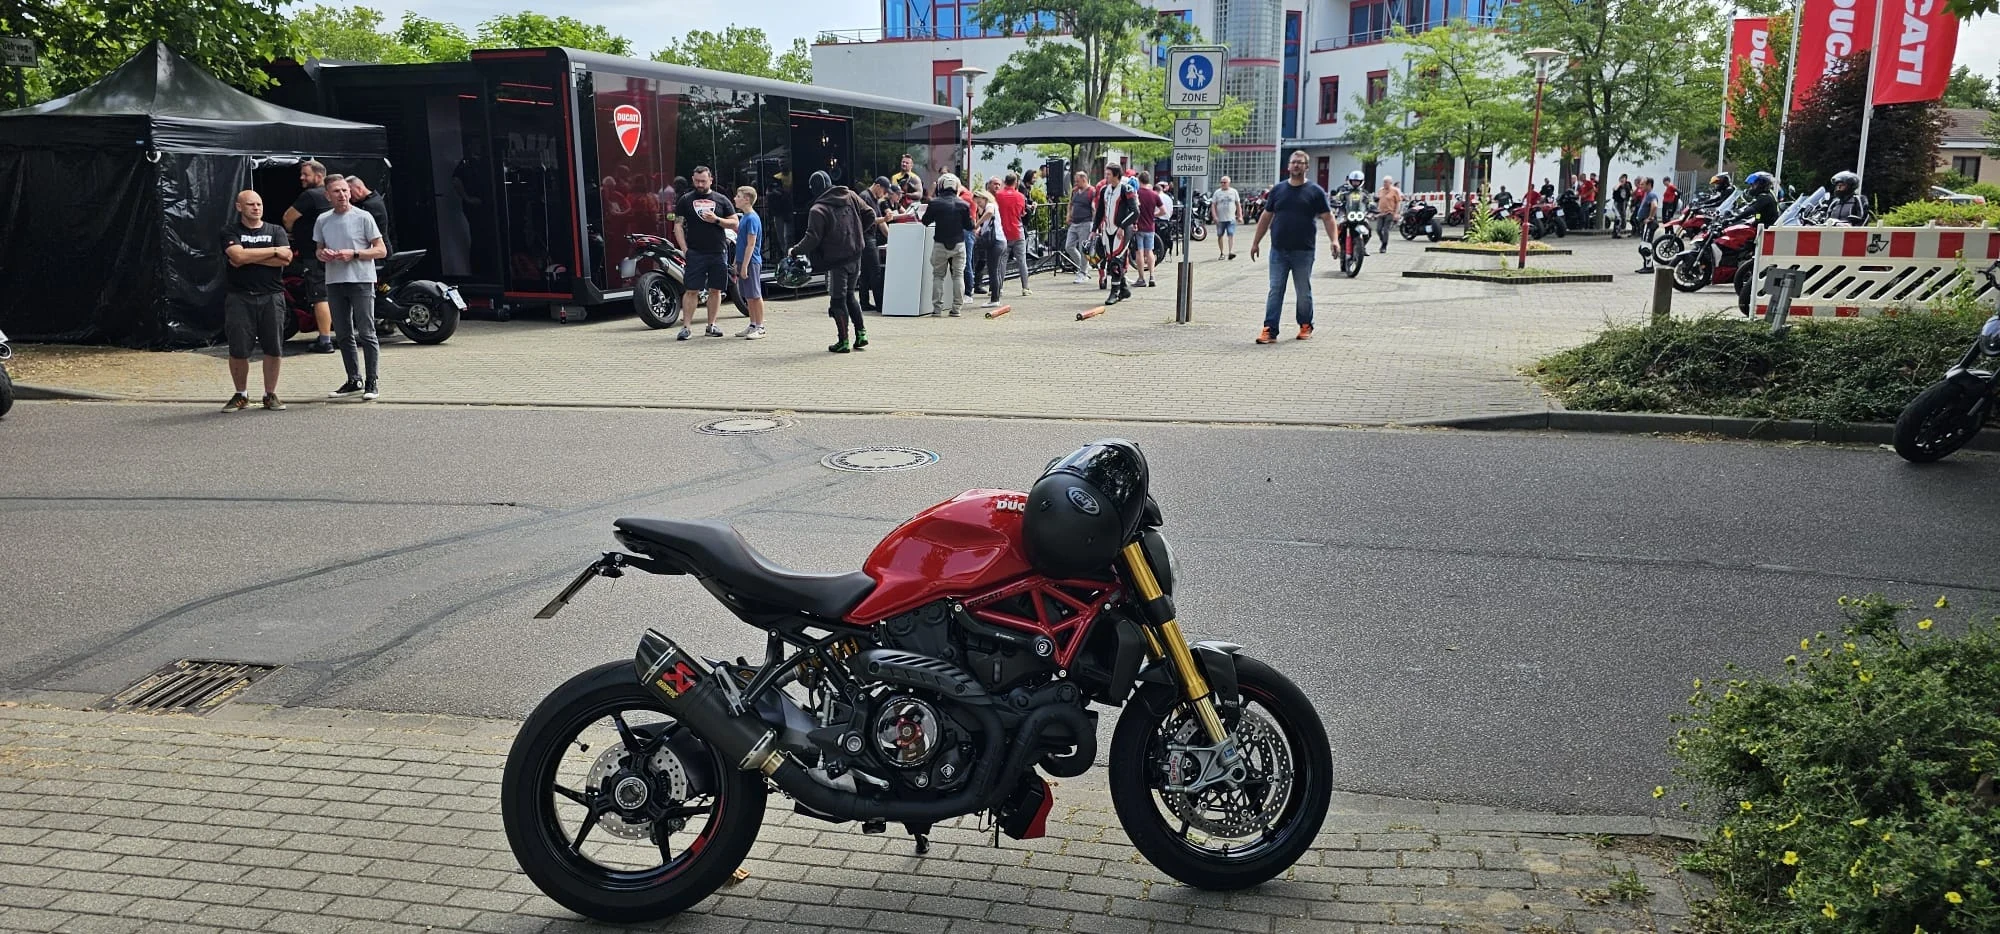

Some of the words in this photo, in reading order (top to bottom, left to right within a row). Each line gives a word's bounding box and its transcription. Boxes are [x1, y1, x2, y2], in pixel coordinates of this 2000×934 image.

[1181, 93, 1208, 102] ZONE
[616, 112, 639, 123] DUCATI
[1175, 153, 1205, 162] Gehweg-
[1176, 162, 1203, 172] schäden
[240, 234, 272, 243] DUCATI
